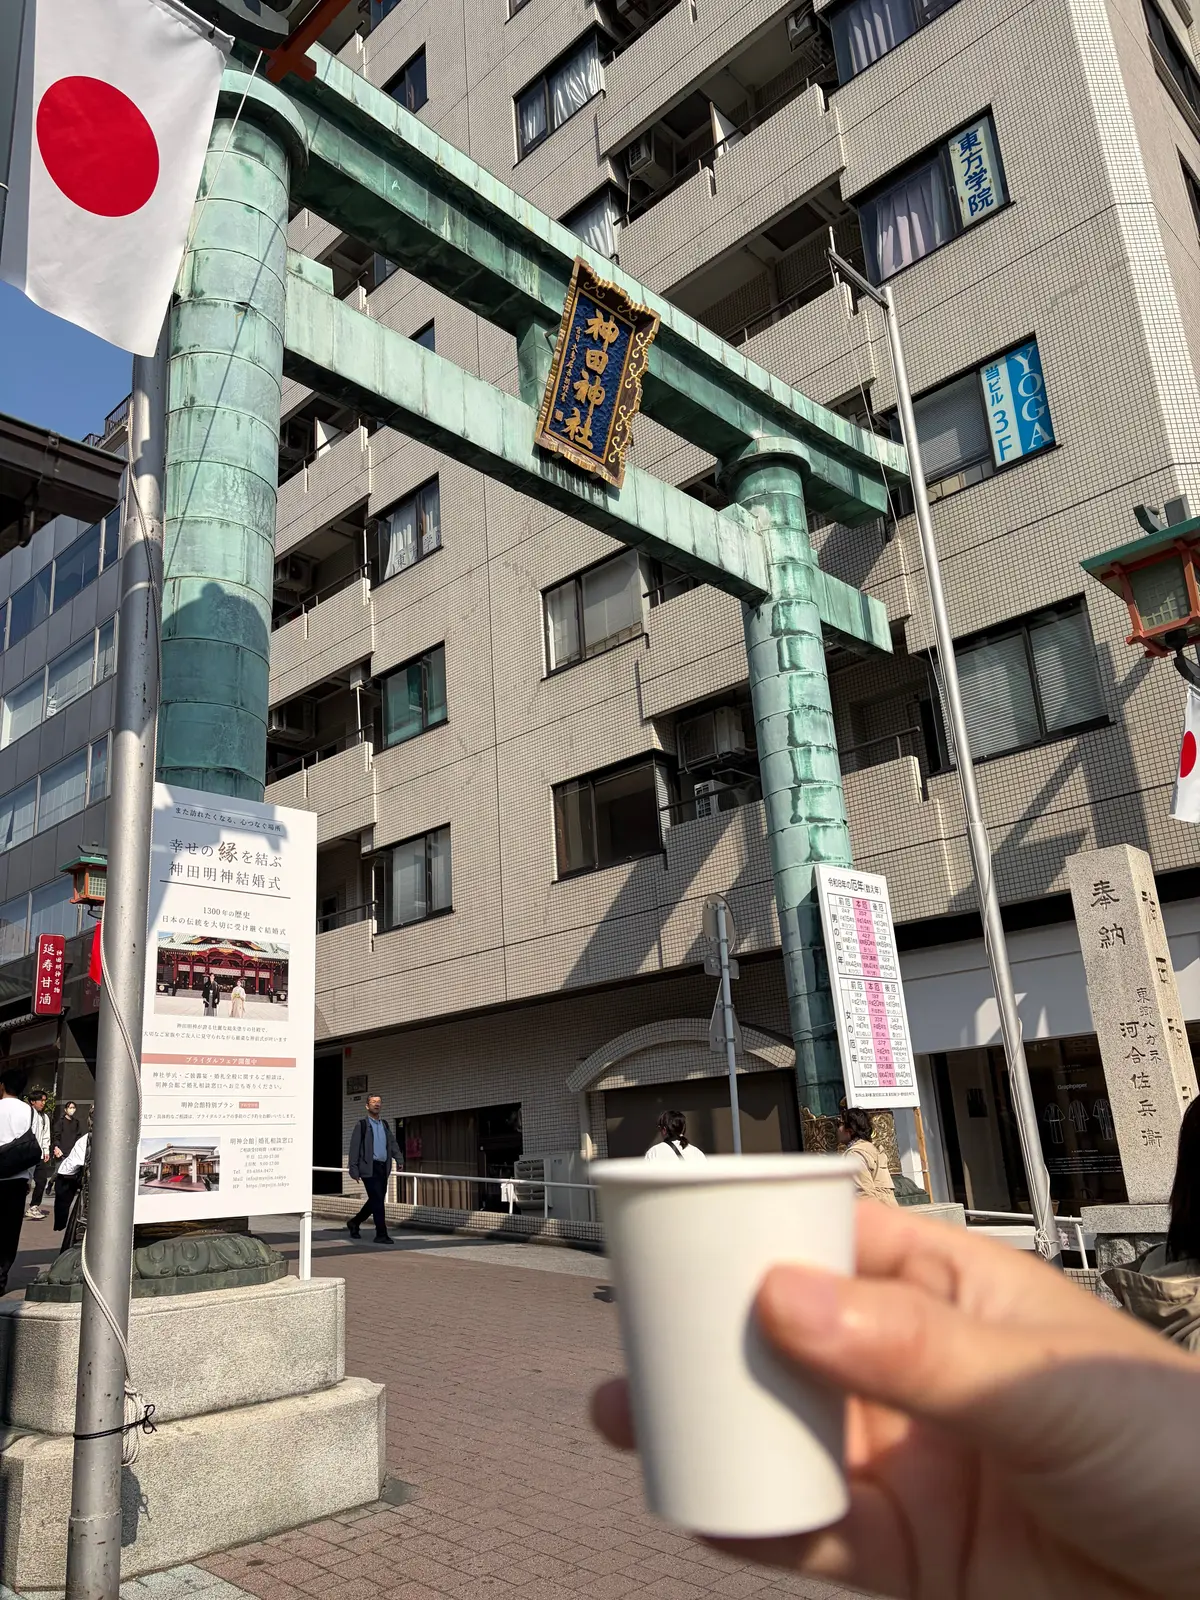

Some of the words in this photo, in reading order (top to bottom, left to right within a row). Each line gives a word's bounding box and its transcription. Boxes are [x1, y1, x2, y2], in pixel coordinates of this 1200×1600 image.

[957, 128, 994, 217] 東方学院
[561, 308, 620, 450] 神田神社
[1010, 344, 1054, 451] YOGA
[175, 806, 282, 833] また訪れたくなる、心つなぐ場所
[169, 838, 283, 869] 幸せの縁を結ぶ
[169, 861, 282, 891] 神田明神結婚式
[162, 915, 287, 936] 日本の伝統を大切に受け継ぐ結婚式
[203, 906, 250, 920] 1300年の歴史
[1090, 880, 1127, 949] 奉納
[39, 943, 55, 1005] 延寿甘酒
[845, 1009, 858, 1063] 女の厄年
